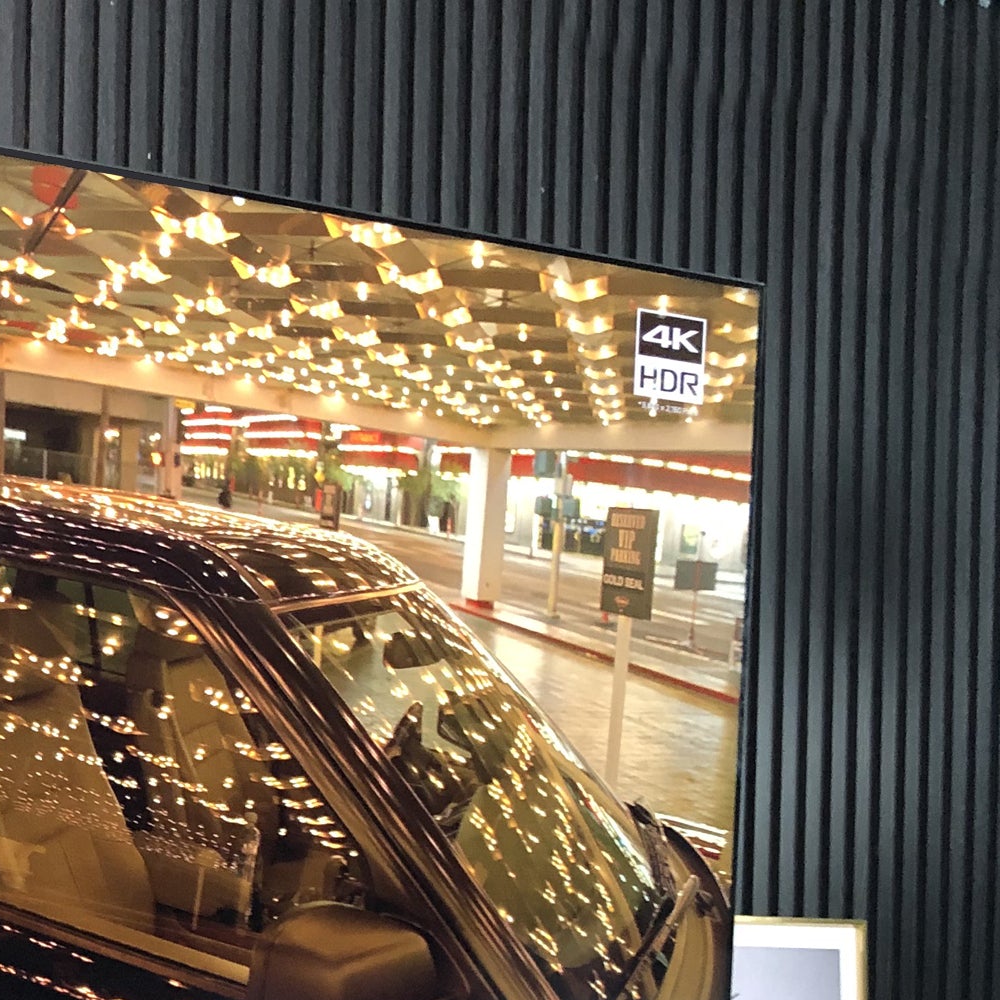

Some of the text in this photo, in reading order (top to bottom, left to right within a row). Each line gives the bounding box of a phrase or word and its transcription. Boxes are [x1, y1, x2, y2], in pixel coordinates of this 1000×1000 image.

[642, 324, 700, 354] 4K
[640, 365, 699, 396] HDR
[619, 529, 636, 549] VIP
[611, 547, 641, 565] PARKING
[603, 573, 624, 587] GOLD
